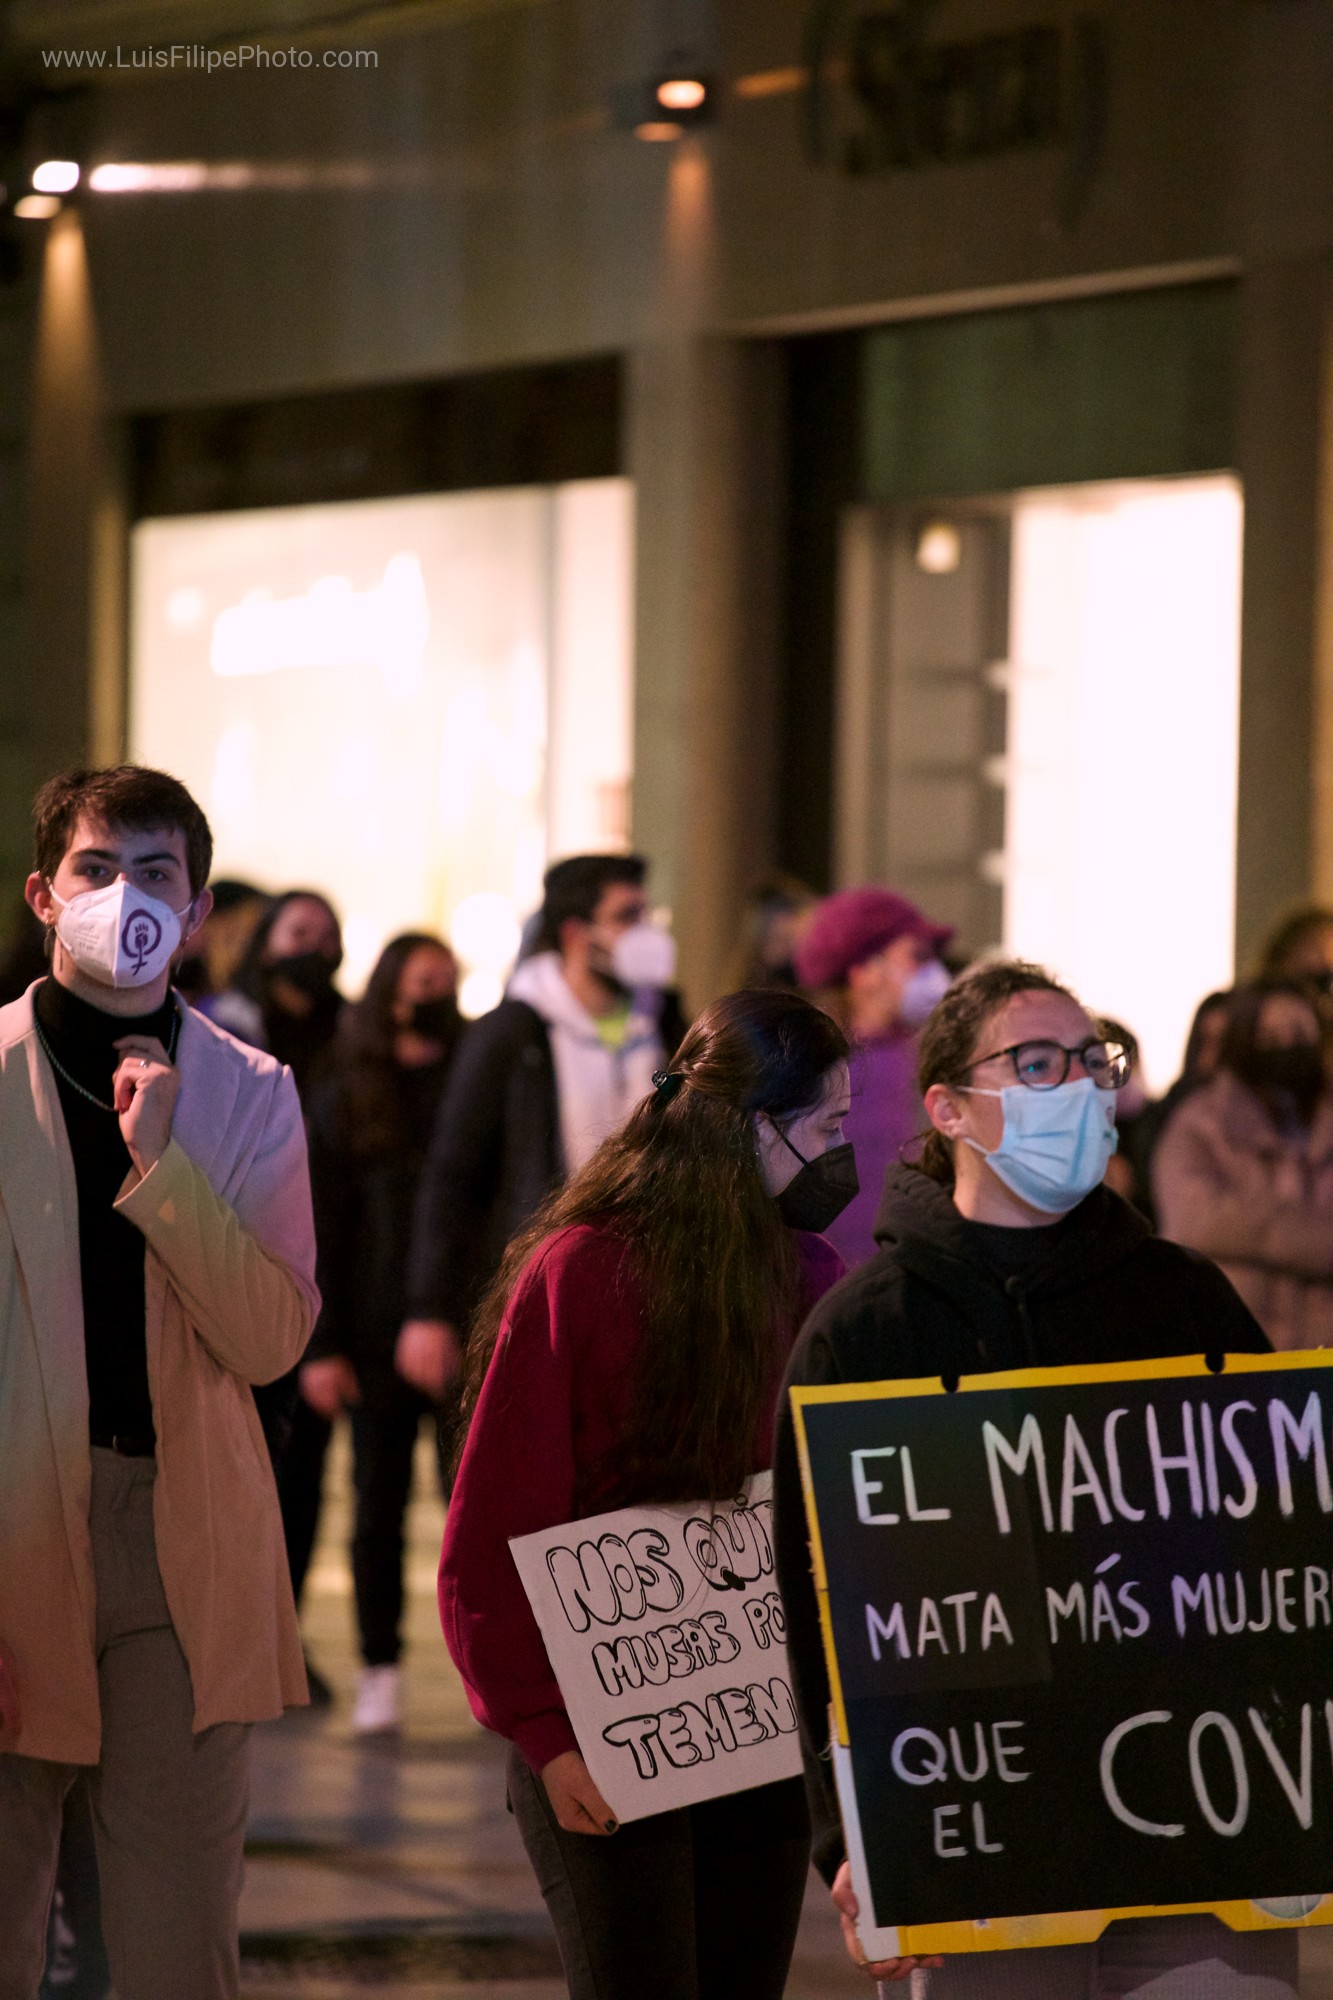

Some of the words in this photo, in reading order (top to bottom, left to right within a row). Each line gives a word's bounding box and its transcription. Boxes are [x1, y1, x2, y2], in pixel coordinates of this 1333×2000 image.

[851, 1446, 950, 1524] EL
[983, 1391, 1333, 1533] MACHISM
[545, 1528, 684, 1633] NOS
[683, 1500, 774, 1591] QUI
[865, 1592, 1014, 1661] MATA
[1045, 1553, 1151, 1644] MÁS
[1171, 1565, 1333, 1639] MUJER
[591, 1610, 741, 1696] MUSAS
[602, 1677, 799, 1779] TEMEN
[891, 1721, 1033, 1786] QUE
[933, 1801, 1004, 1858] EL
